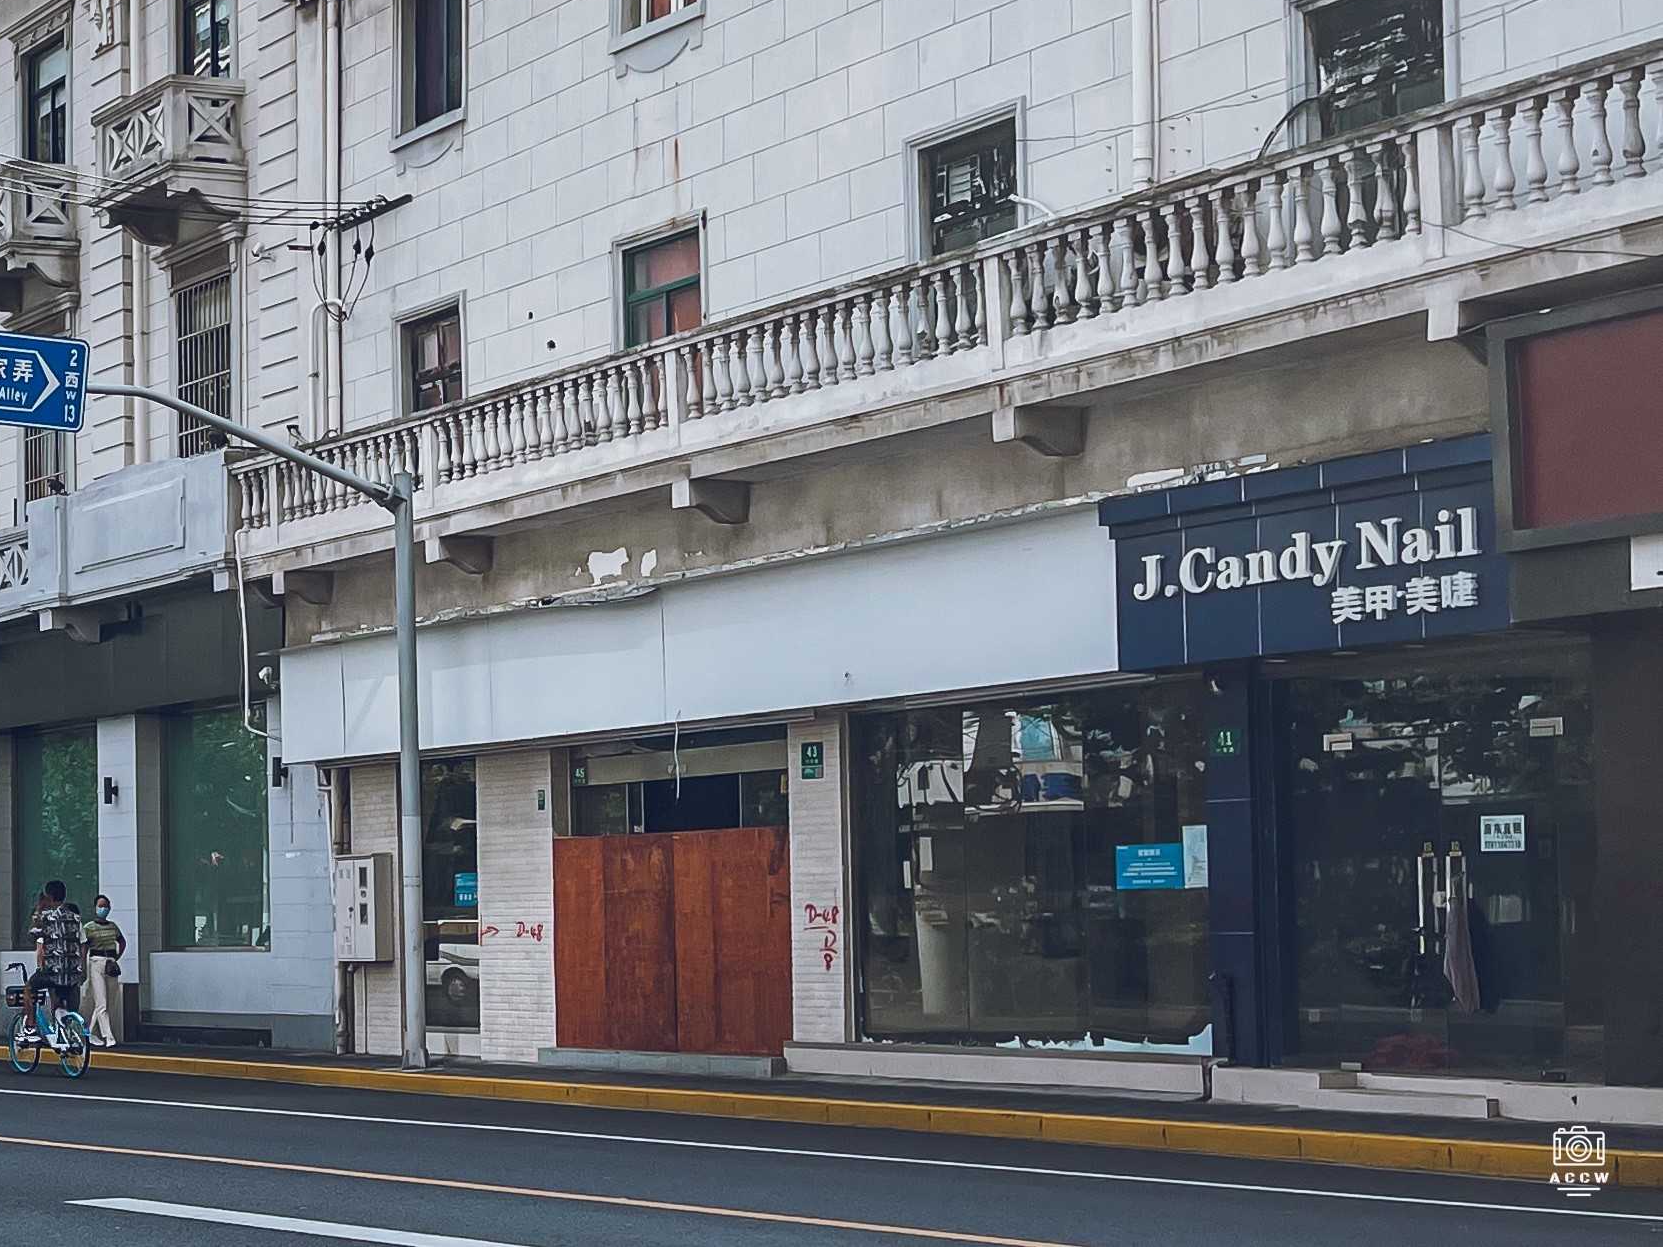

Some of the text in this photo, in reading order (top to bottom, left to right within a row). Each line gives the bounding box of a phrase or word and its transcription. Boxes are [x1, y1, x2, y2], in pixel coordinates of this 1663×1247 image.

[69, 349, 78, 367] 2
[64, 371, 80, 388] 西
[64, 404, 75, 423] 13
[1133, 507, 1482, 601] J.Candy Nail
[806, 745, 818, 758] 43
